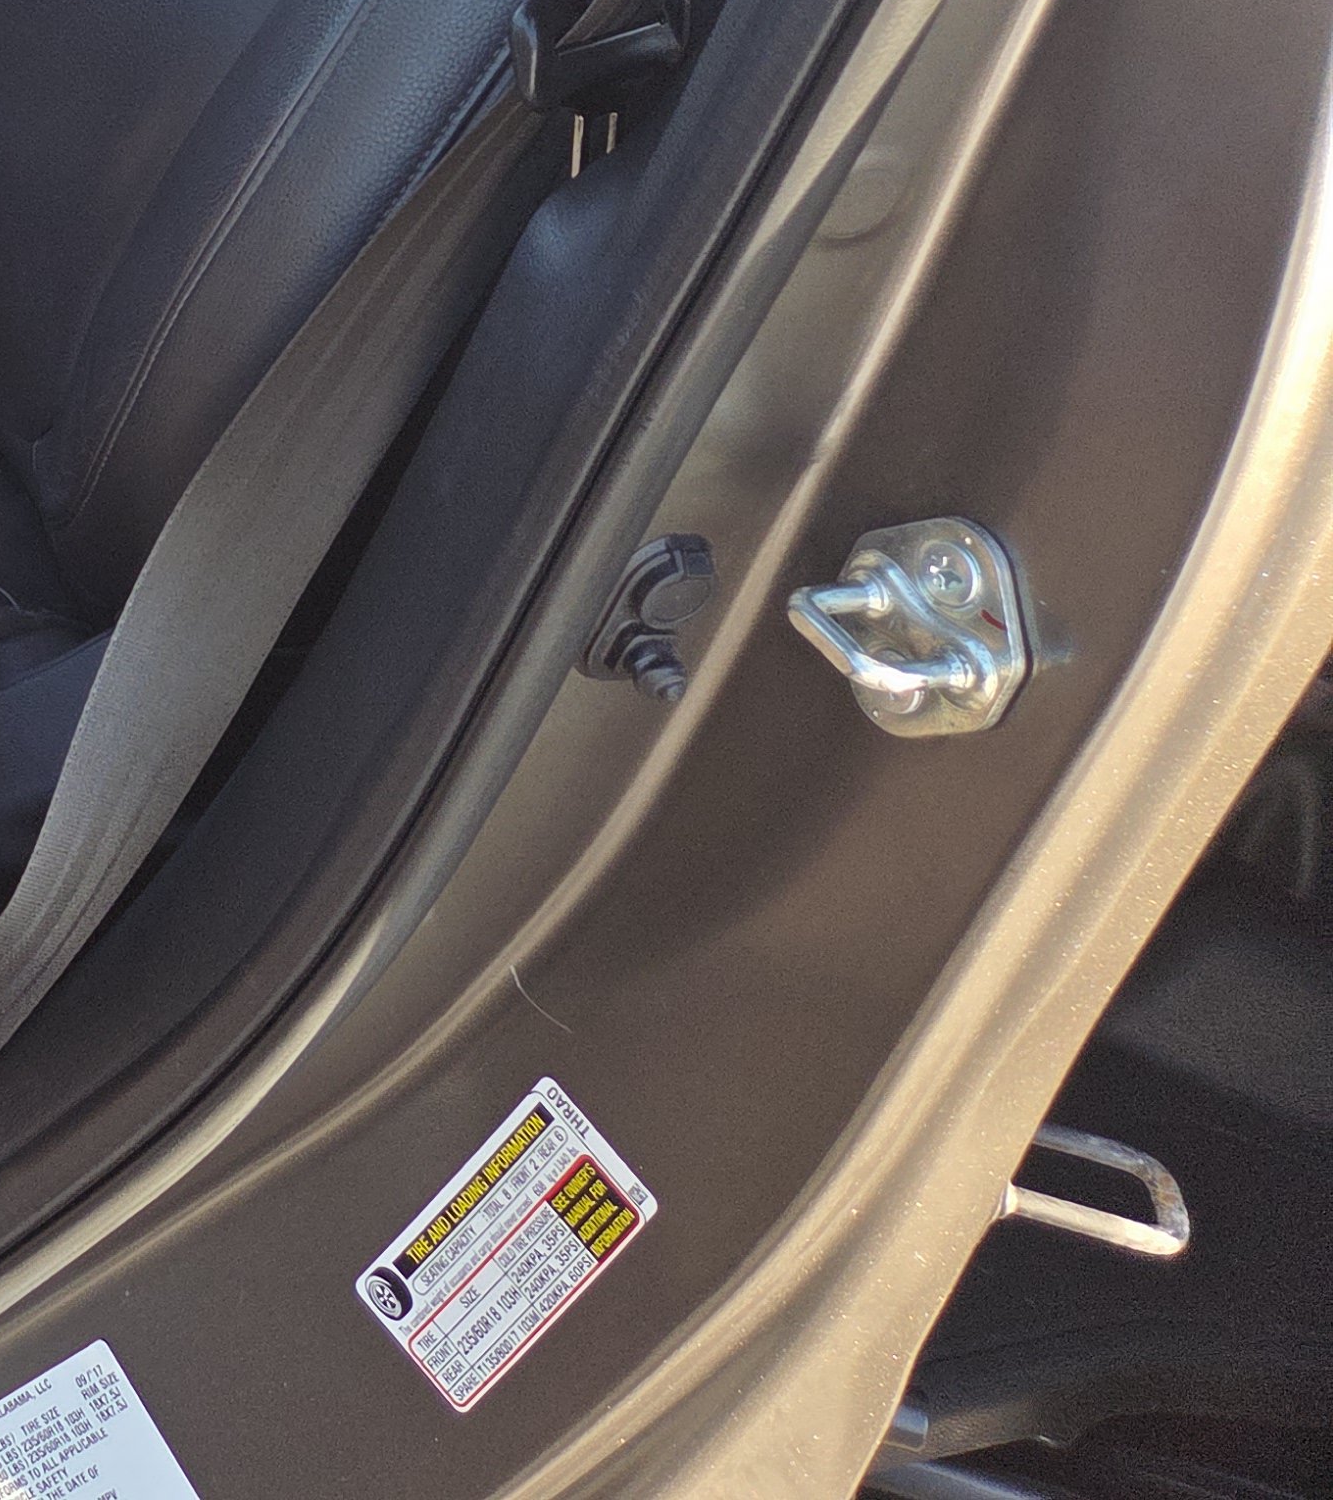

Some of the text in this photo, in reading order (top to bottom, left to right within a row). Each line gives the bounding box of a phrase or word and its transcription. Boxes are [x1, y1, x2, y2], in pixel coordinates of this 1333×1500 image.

[406, 1112, 545, 1263] TIRE AND LOADING INFORMATION
[420, 1254, 450, 1286] SEATING
[445, 1224, 477, 1261] CAPACITY
[483, 1198, 505, 1219] TOTAL
[502, 1188, 512, 1200] 8
[511, 1165, 532, 1190] FRONT
[529, 1157, 540, 1171] 2
[537, 1137, 557, 1160] REAR
[554, 1130, 564, 1142] 6
[552, 1191, 570, 1212] SEE
[564, 1162, 596, 1198] OWNER'S
[564, 1179, 607, 1227] MANUAL FOR
[578, 1199, 618, 1242] ADDITIONAL
[590, 1207, 635, 1257] INFORMATION
[417, 1329, 438, 1351] TIRE
[459, 1284, 481, 1308] SIZE
[498, 1246, 517, 1268] COLD
[511, 1233, 529, 1252] TIRE
[523, 1206, 554, 1241] PRESSURE
[427, 1340, 453, 1371] FRONT
[542, 1221, 568, 1251] 35PSI
[442, 1359, 465, 1384] REAR
[555, 1237, 581, 1266] 35PSI
[454, 1372, 480, 1401] SPARE
[568, 1252, 595, 1282] 60PSI
[457, 1285, 522, 1355] 235/60R18 103H
[21, 1417, 42, 1436] TIRE
[41, 1405, 61, 1424] SIZE
[81, 1382, 100, 1400] RIM
[99, 1371, 120, 1389] SIZE
[34, 1377, 52, 1395] LLC
[64, 1407, 86, 1426] 103H
[71, 1418, 93, 1437] 103H
[28, 1466, 41, 1480] TO
[42, 1456, 60, 1474] ALL
[59, 1427, 109, 1463] APPLICABLE
[65, 1471, 89, 1492] DATE
[88, 1464, 99, 1479] OF
[36, 1466, 69, 1493] SAFETY
